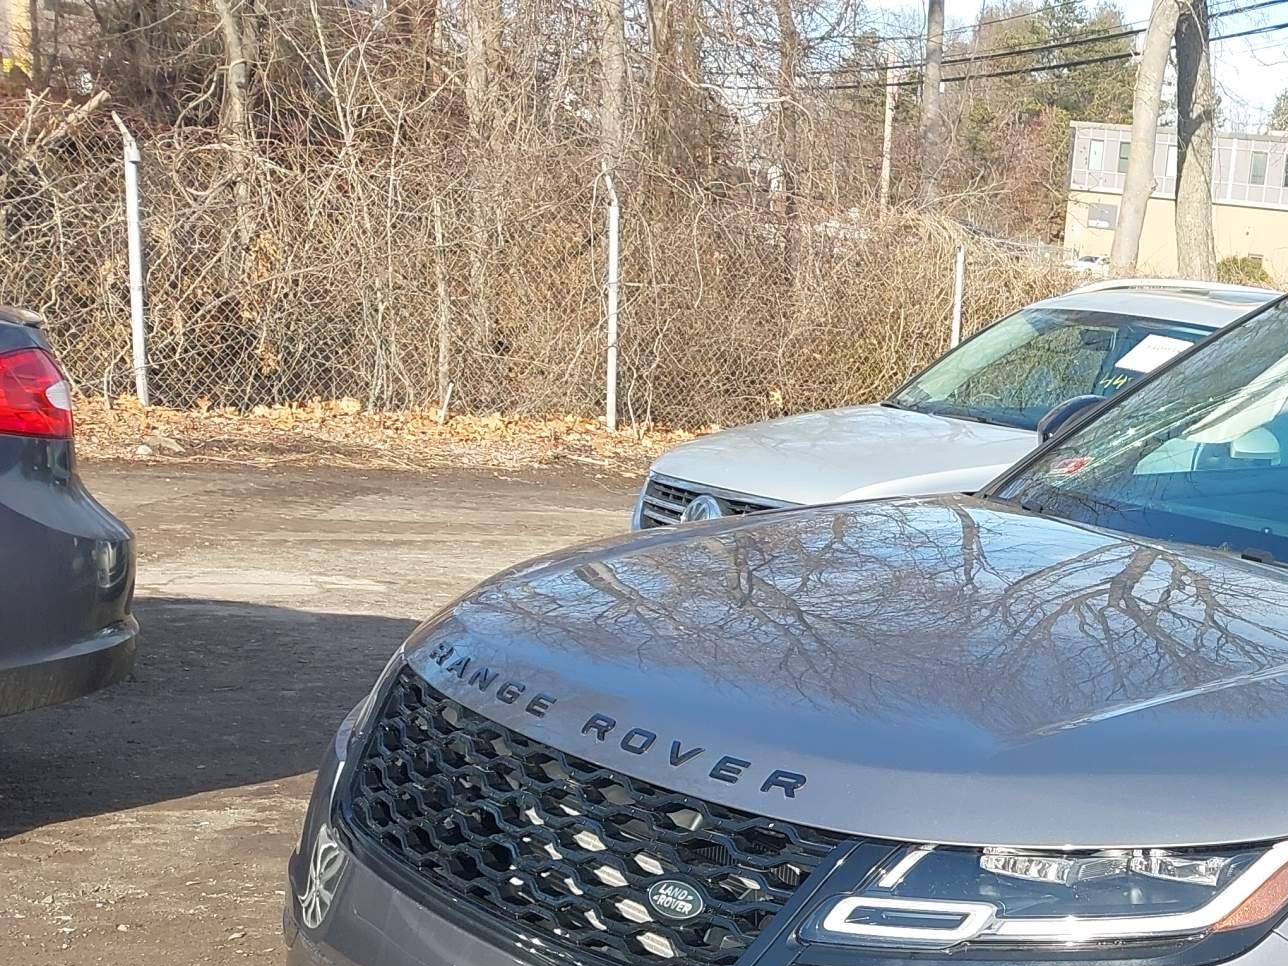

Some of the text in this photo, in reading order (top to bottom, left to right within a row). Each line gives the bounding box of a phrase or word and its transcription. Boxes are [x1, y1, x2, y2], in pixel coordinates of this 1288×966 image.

[428, 640, 808, 799] RANGE ROVER
[658, 883, 688, 900] LAND
[656, 894, 693, 915] ROVER
